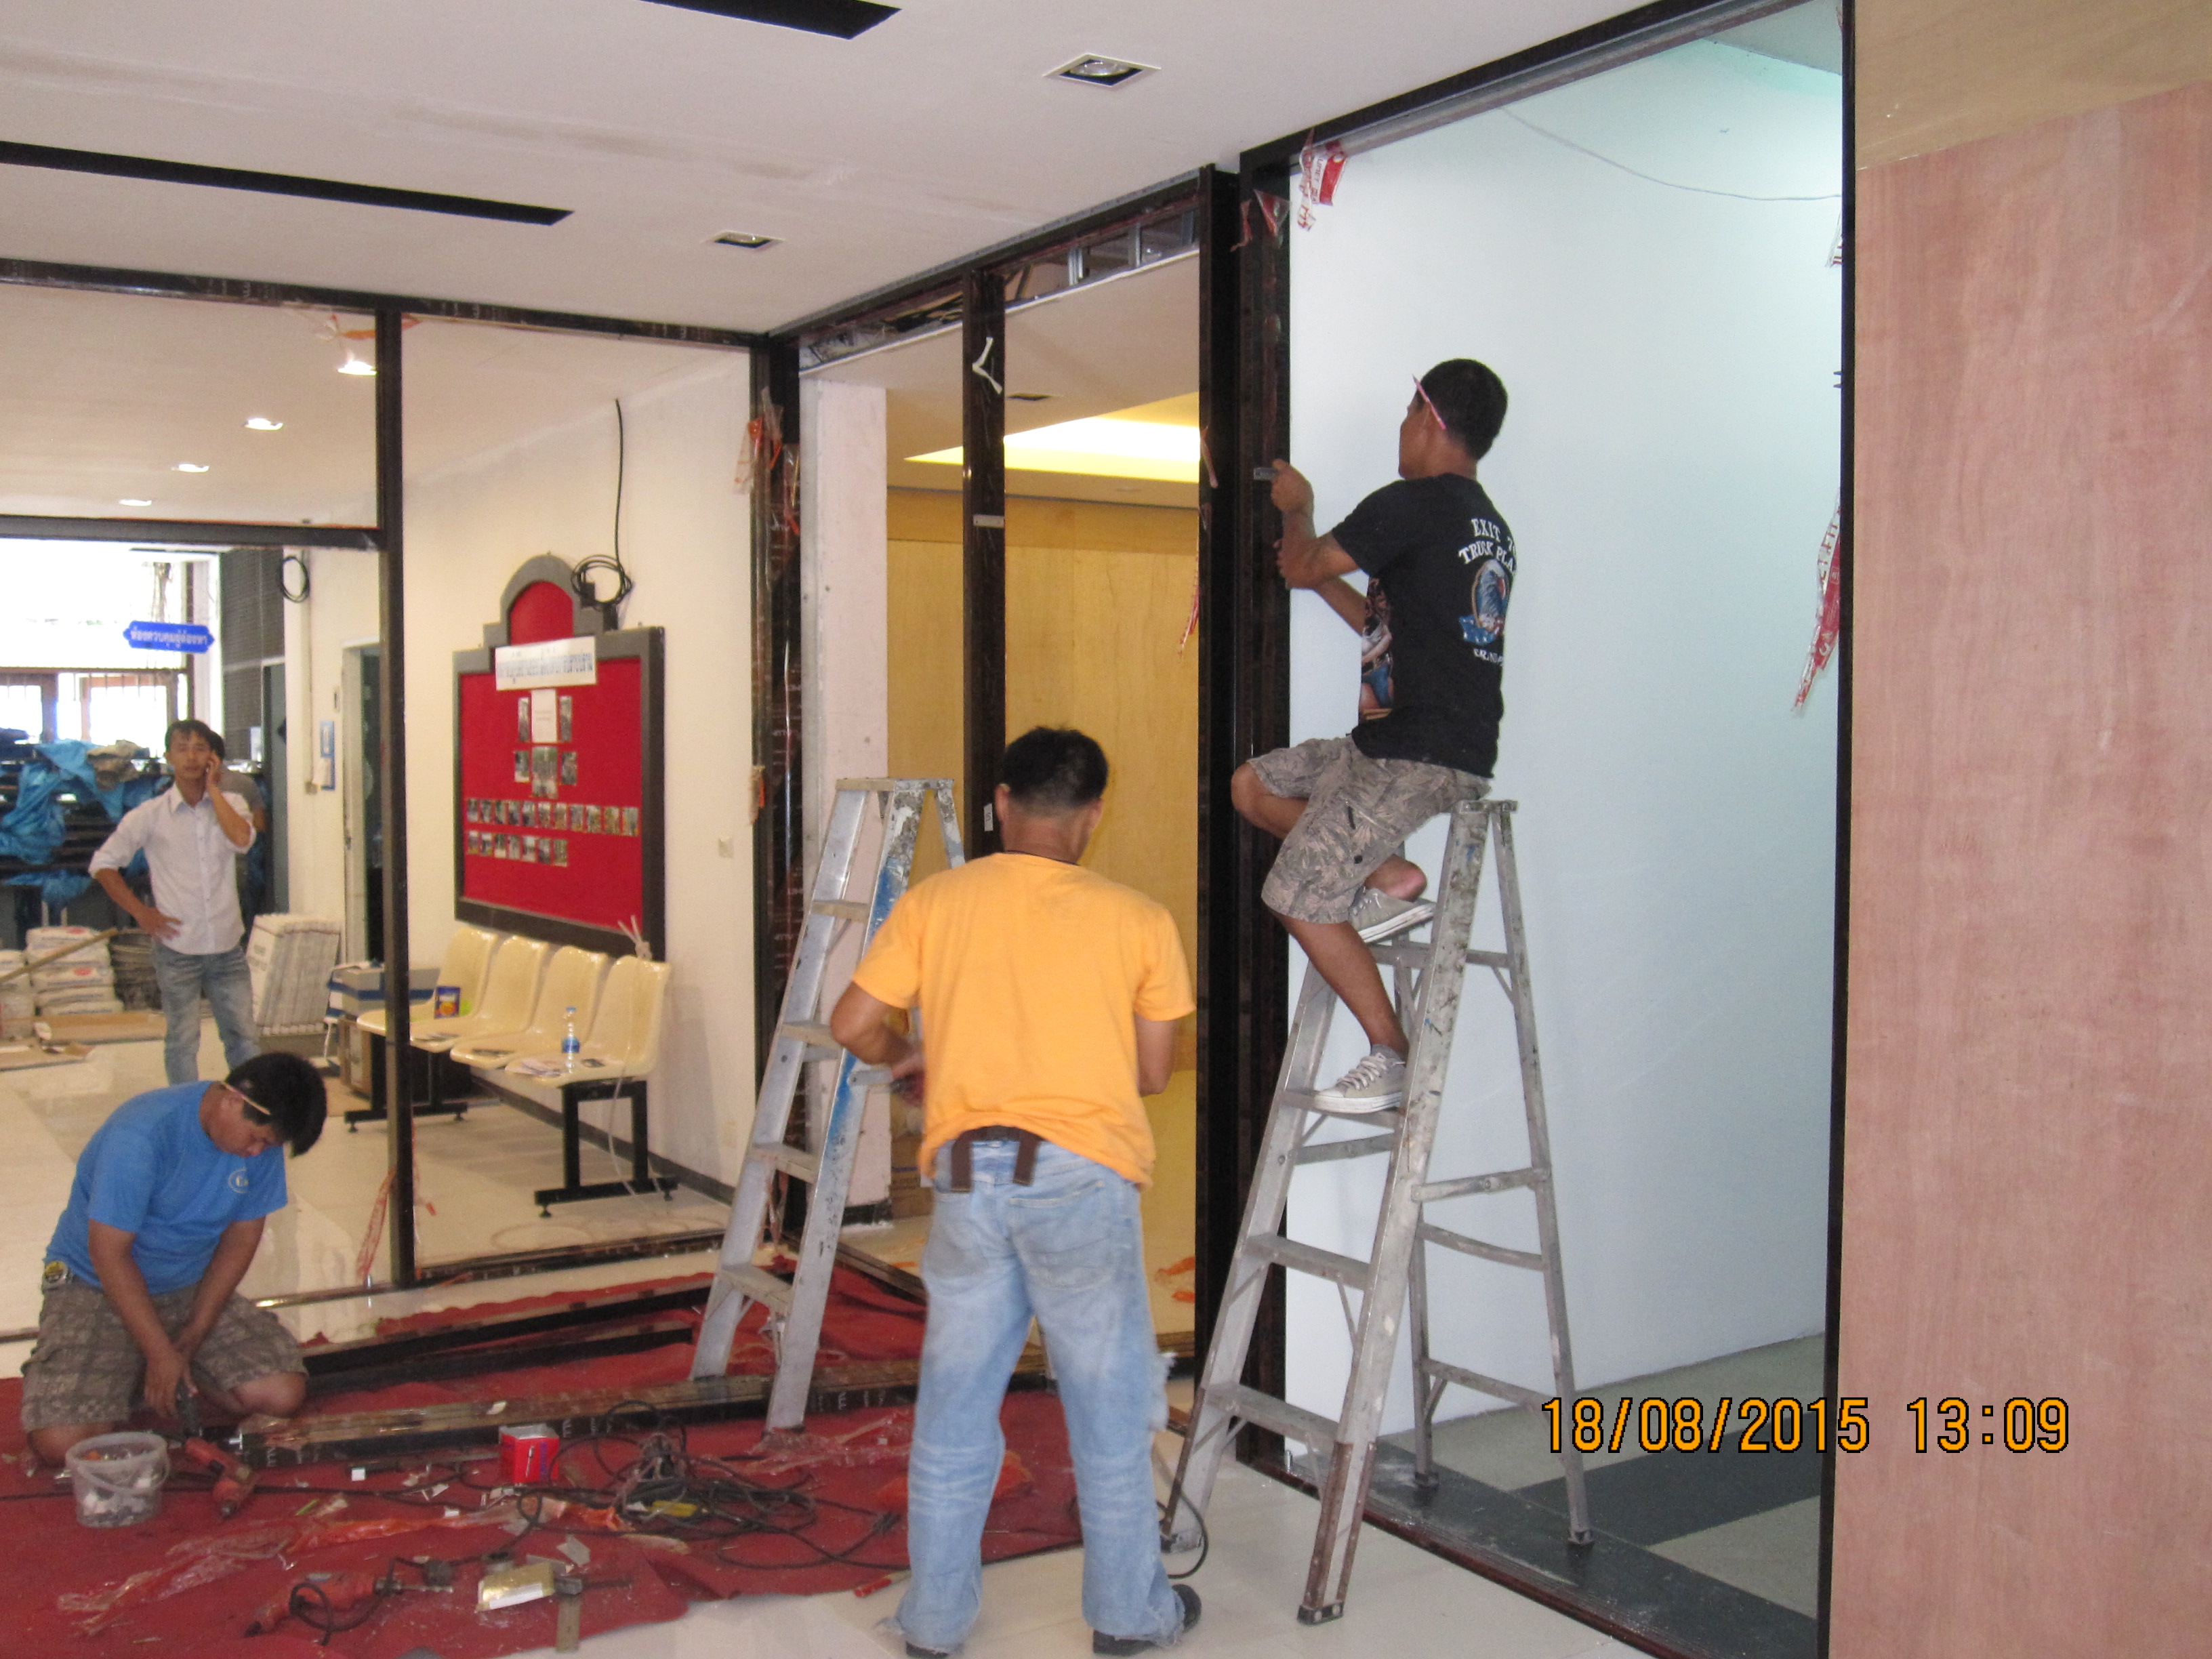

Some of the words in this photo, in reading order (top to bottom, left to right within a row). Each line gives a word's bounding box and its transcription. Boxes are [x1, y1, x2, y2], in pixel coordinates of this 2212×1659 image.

[1471, 518, 1501, 543] EXIT
[1458, 540, 1494, 565] TRUCK
[1496, 546, 1515, 573] PLA
